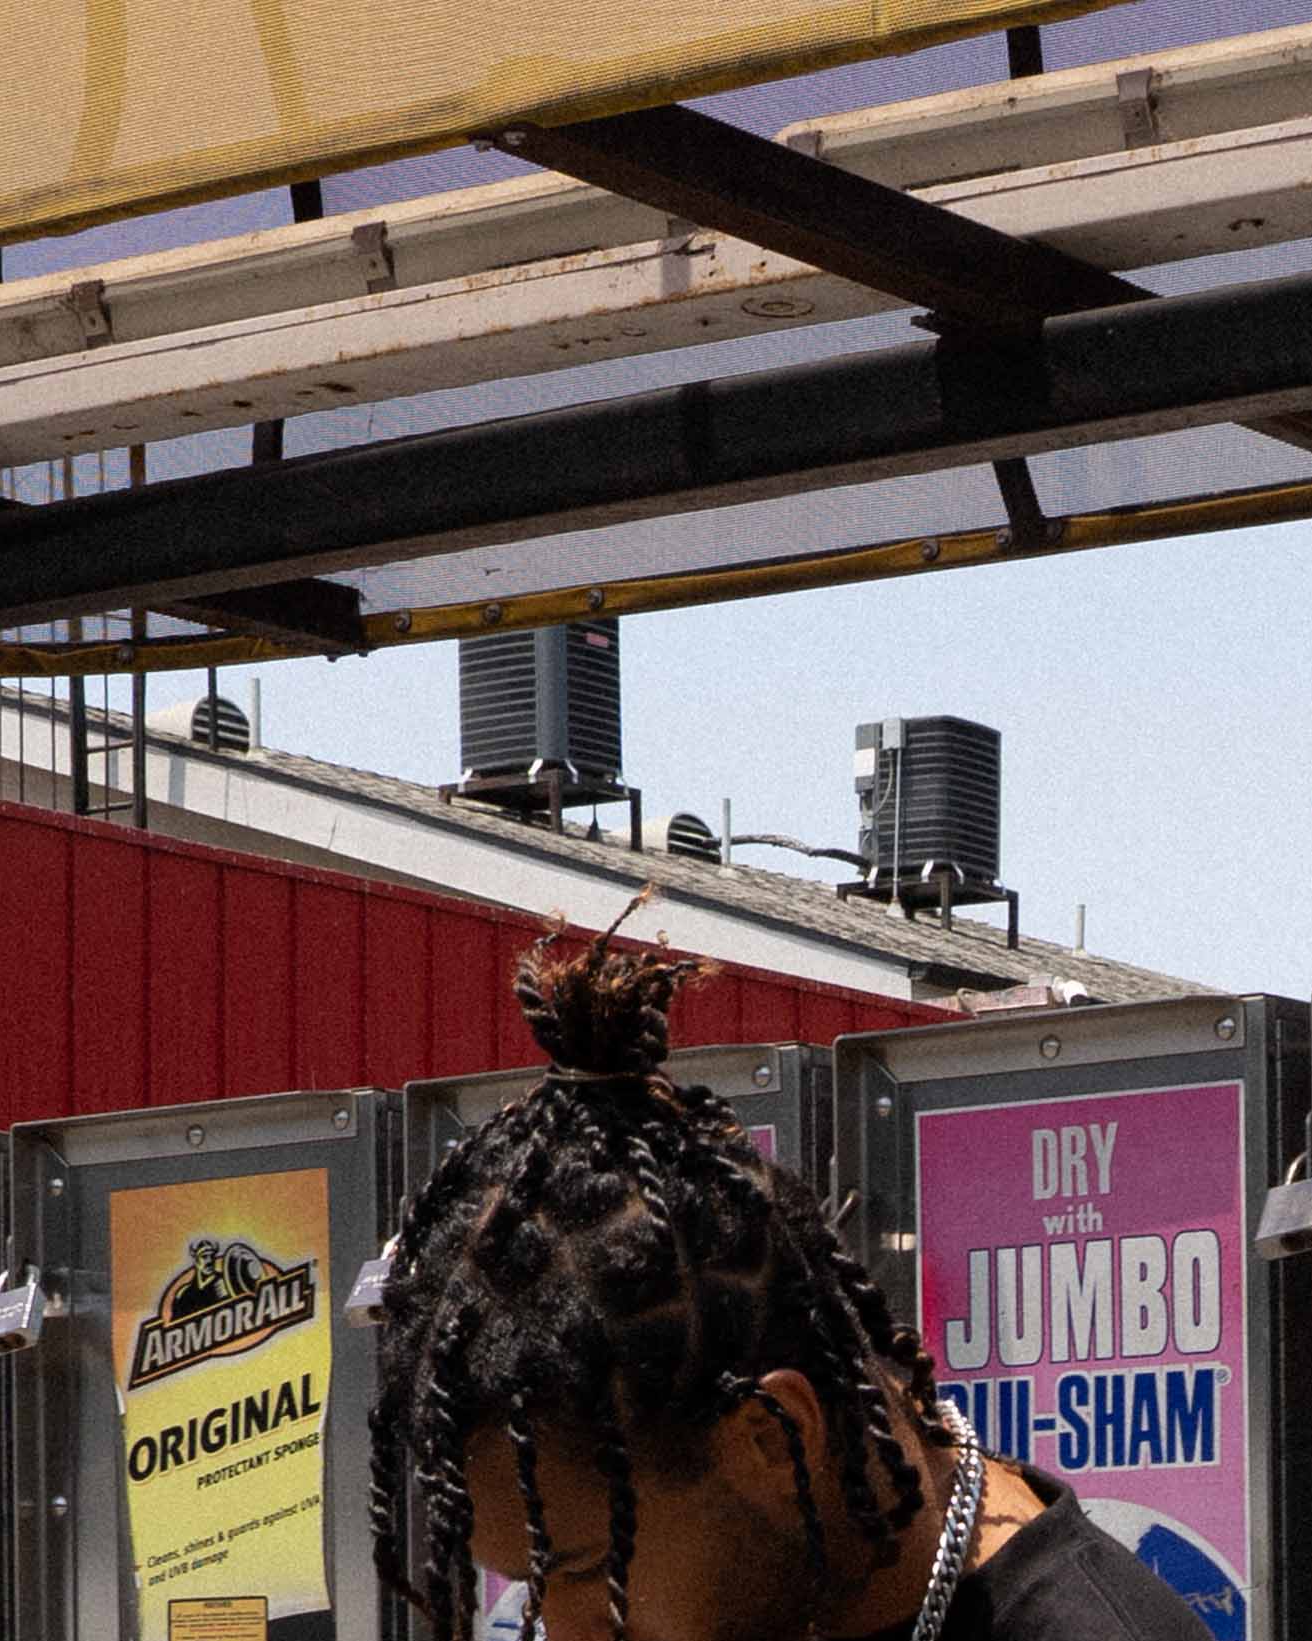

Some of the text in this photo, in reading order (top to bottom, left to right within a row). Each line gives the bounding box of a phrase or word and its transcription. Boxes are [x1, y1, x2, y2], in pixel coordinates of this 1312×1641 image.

[1032, 1121, 1118, 1200] DRY
[1042, 1205, 1104, 1236] with
[944, 1229, 1223, 1370] JUMBO
[129, 1373, 322, 1481] ORIGINAL
[196, 1432, 320, 1490] PROTECTANT SPONGE
[184, 1536, 215, 1555] shines
[228, 1519, 260, 1541] guards
[262, 1504, 299, 1527] against
